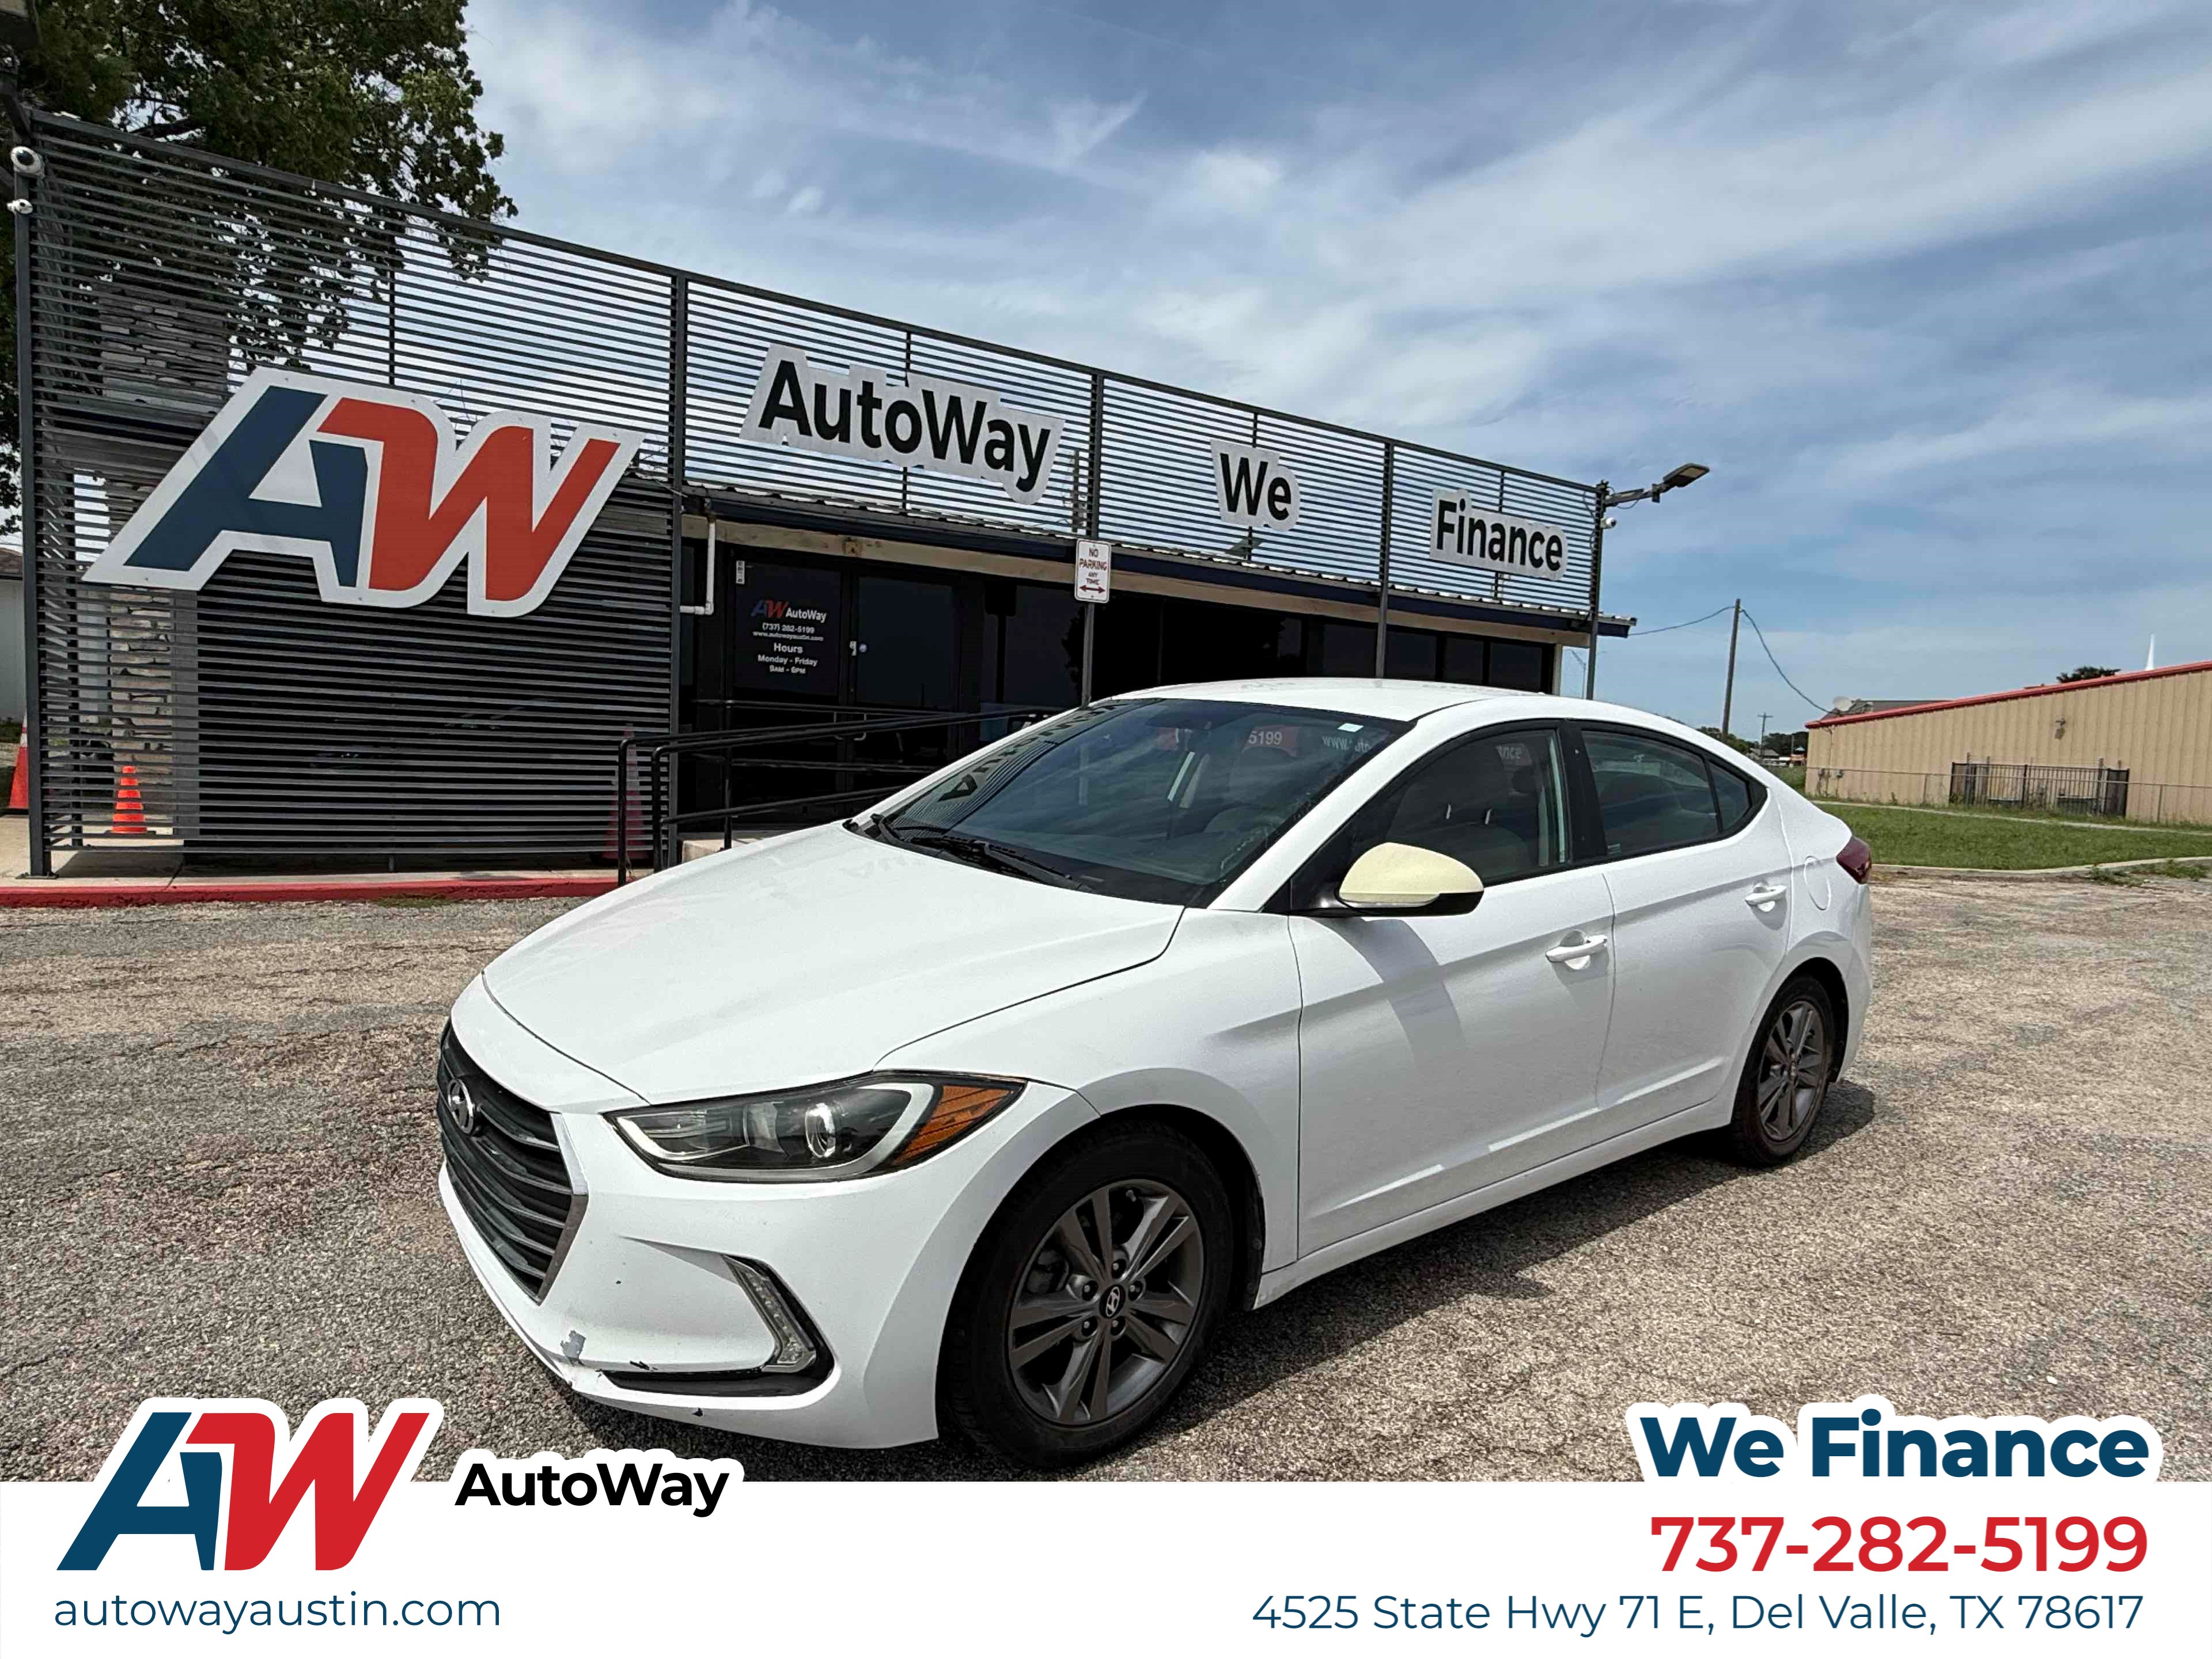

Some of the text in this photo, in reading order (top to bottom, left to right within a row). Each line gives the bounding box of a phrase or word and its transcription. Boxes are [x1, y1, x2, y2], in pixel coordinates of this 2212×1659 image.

[758, 359, 1563, 571] AutoWay We Finance
[123, 385, 620, 601] AW
[1089, 548, 1098, 557] NO
[1080, 559, 1107, 570] PARKING
[786, 608, 827, 623] AutoWay
[763, 622, 780, 631] (737)
[774, 643, 803, 653] Hours
[757, 654, 789, 664] Monday
[795, 657, 817, 666] Friday
[1248, 731, 1282, 745] 5199
